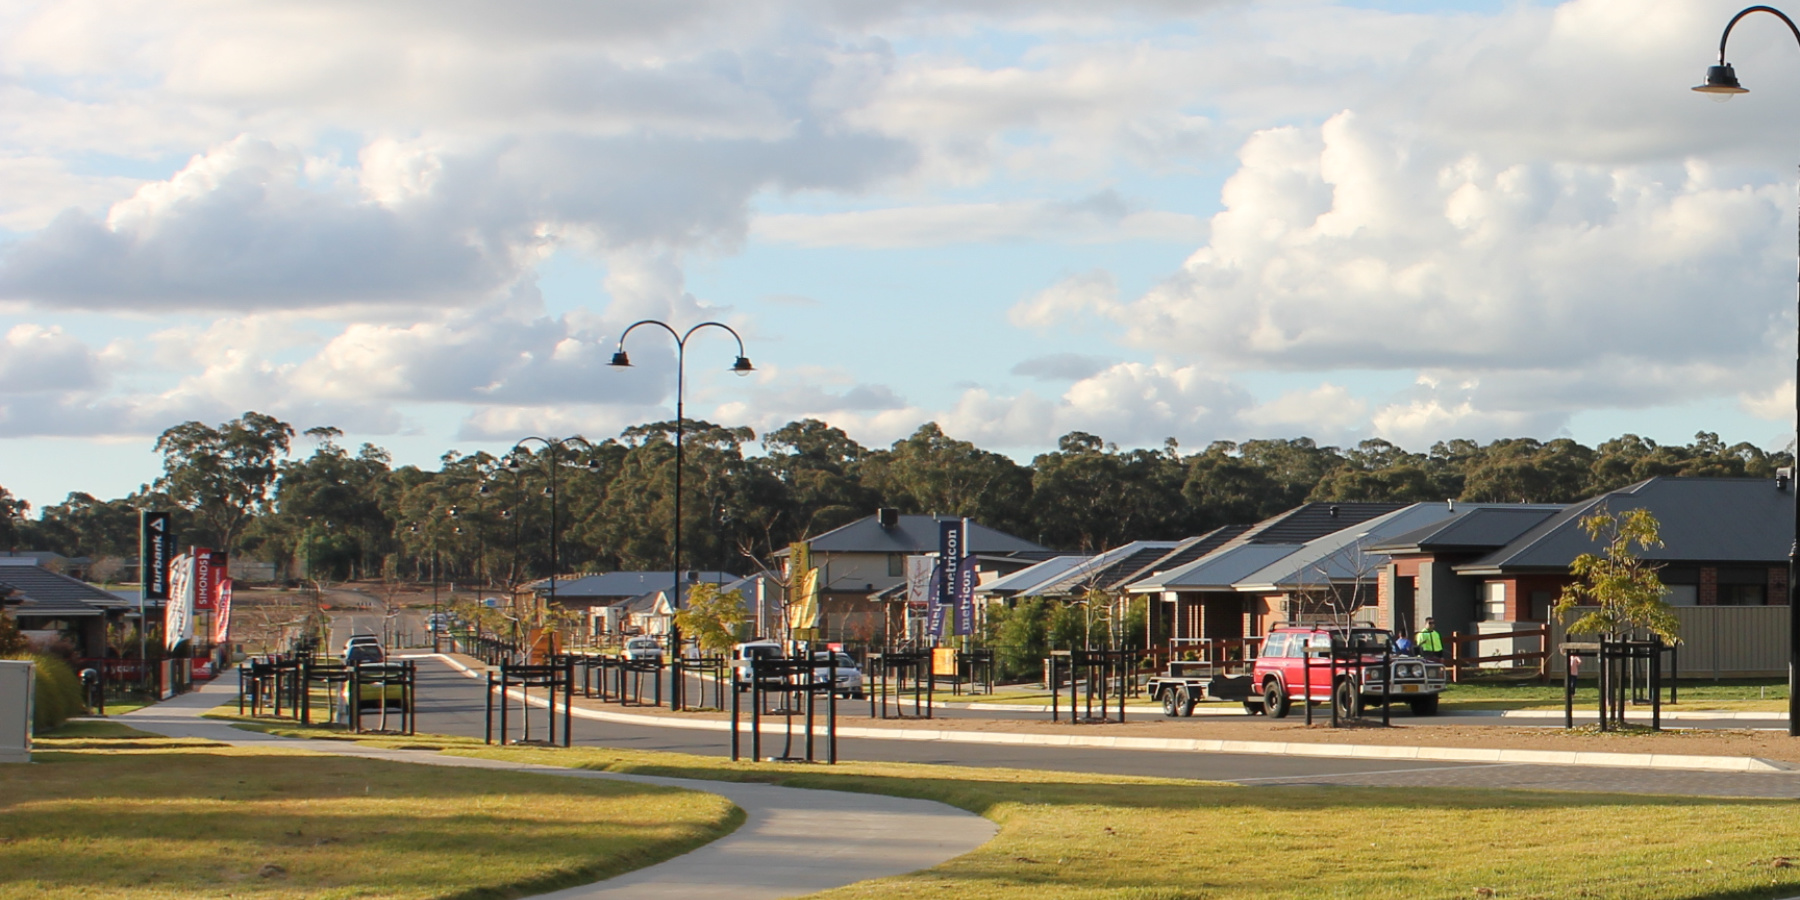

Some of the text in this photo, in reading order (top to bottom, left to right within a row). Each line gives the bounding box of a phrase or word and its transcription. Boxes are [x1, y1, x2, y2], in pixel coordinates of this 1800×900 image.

[153, 535, 163, 593] Burbank
[198, 560, 209, 605] SIMONDS
[944, 529, 957, 596] metricon
[959, 569, 971, 631] metricon
